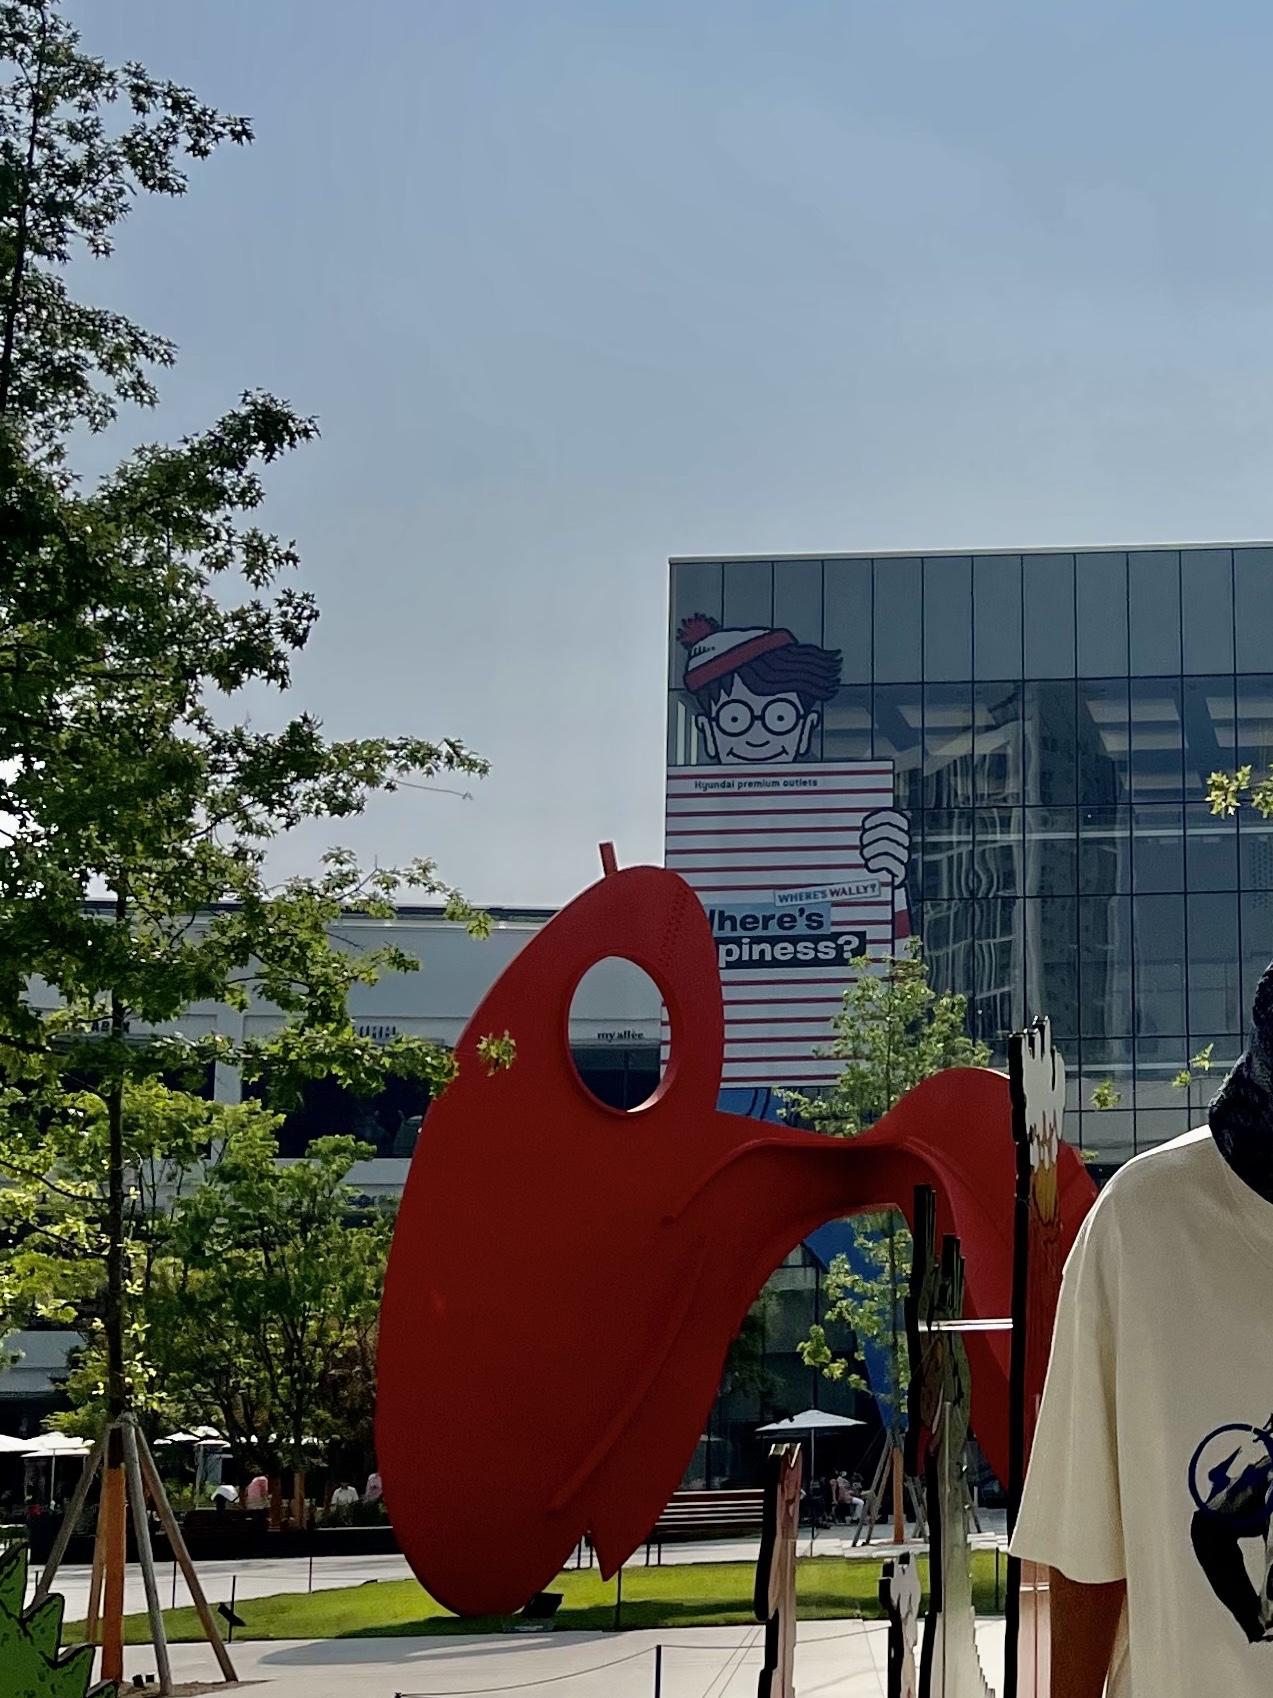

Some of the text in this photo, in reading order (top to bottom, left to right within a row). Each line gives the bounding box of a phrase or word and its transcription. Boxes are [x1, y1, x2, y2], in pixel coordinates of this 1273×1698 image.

[695, 778, 818, 791] Hyundai premium outlets
[778, 883, 878, 904] WHERE'S WALLY?
[597, 1031, 615, 1043] my
